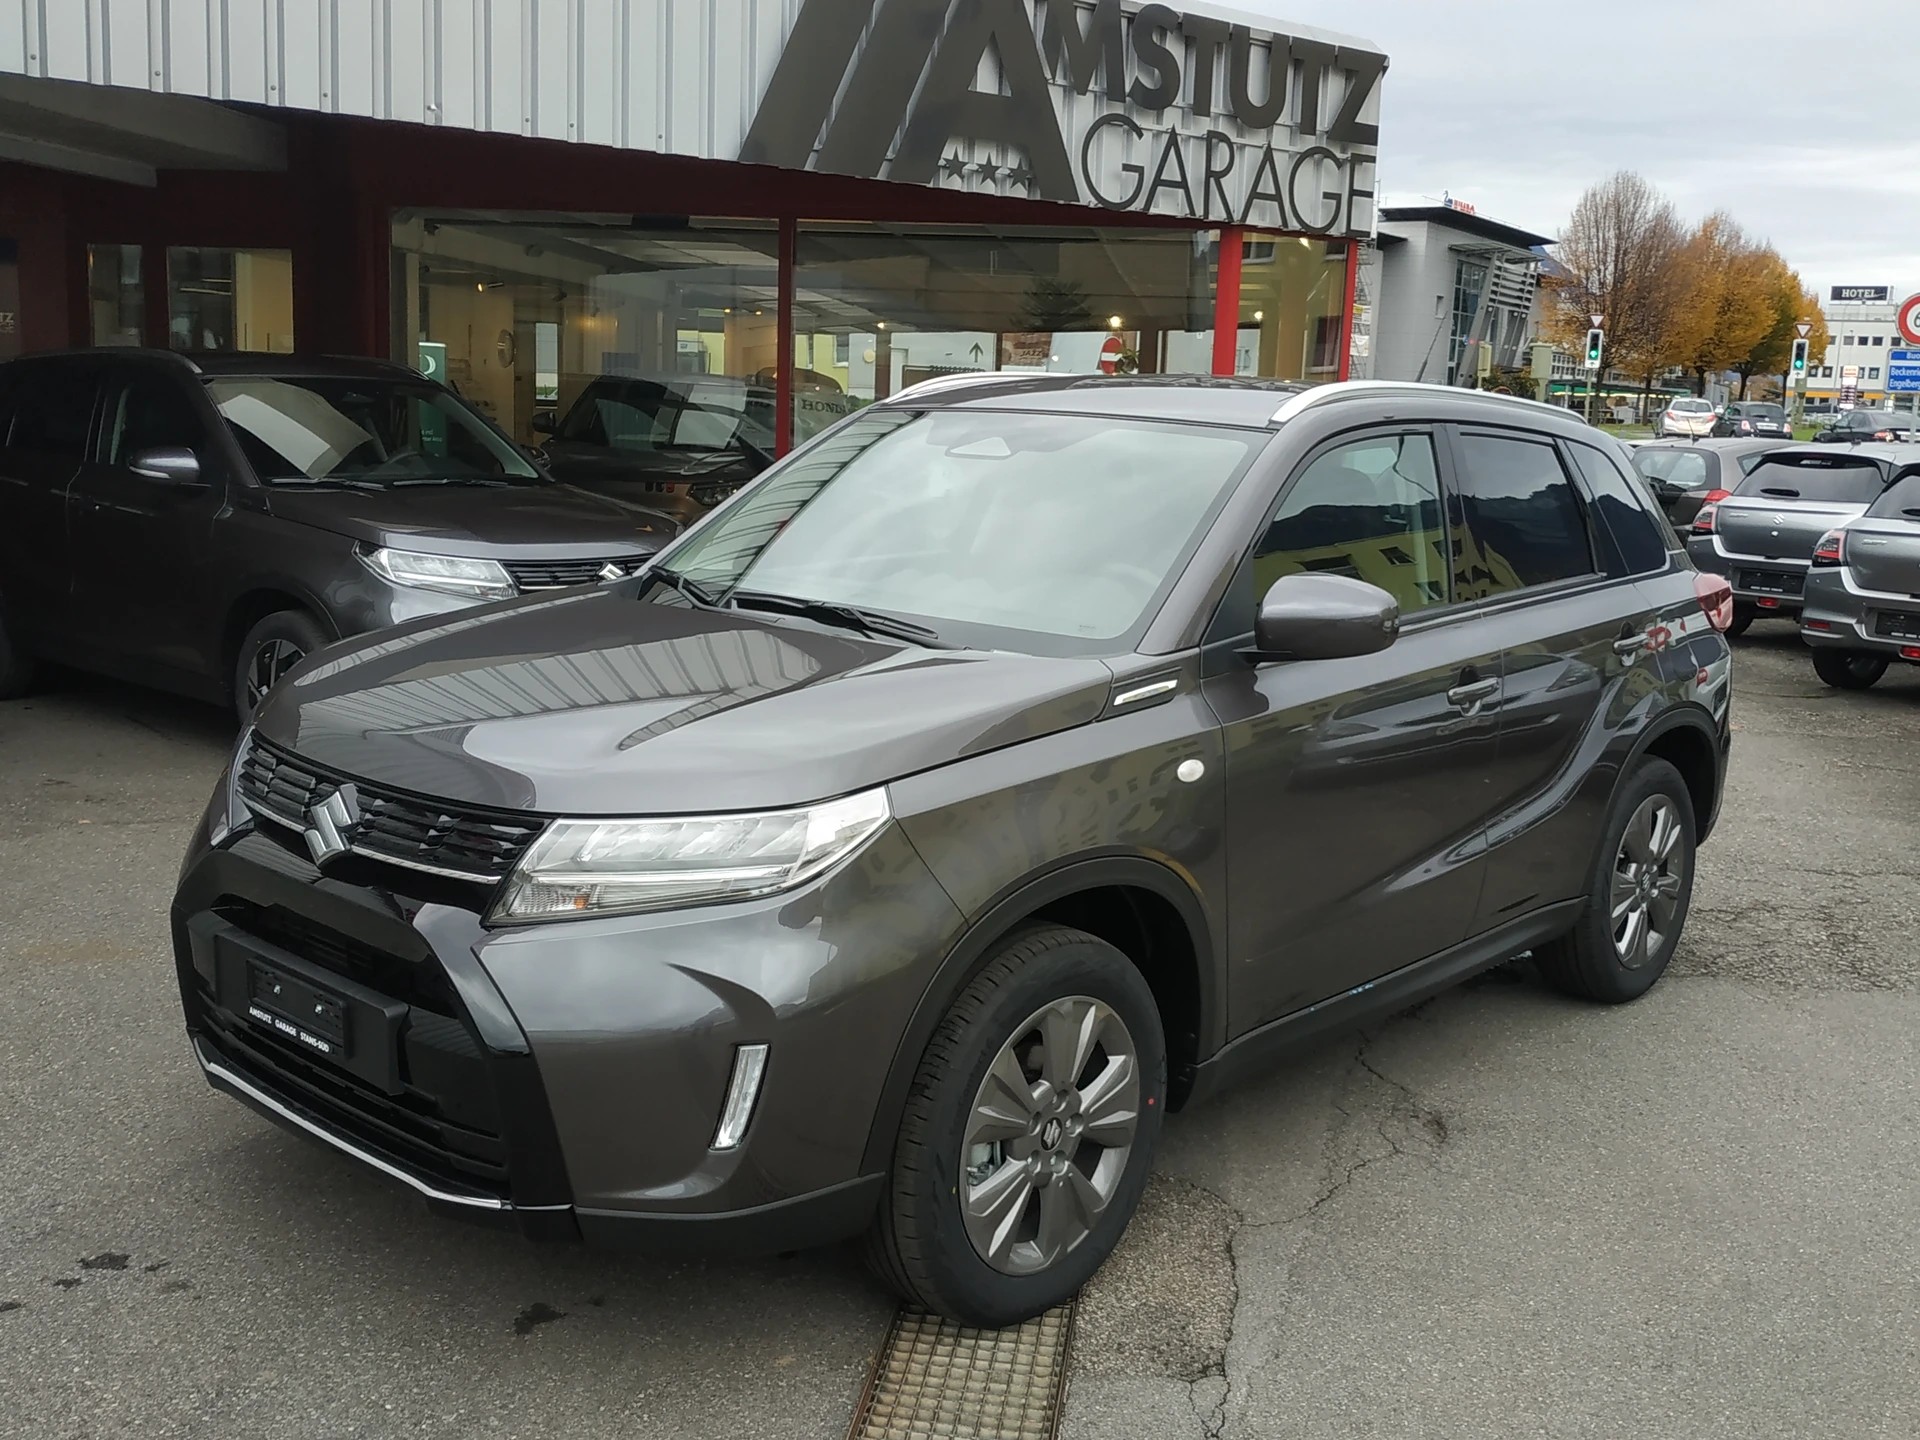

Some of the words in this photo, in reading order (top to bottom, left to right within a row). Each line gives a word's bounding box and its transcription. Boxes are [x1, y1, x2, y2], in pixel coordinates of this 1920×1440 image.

[737, 0, 1389, 202] AMSTUTZ
[1081, 113, 1377, 239] GARAGE
[1841, 289, 1875, 298] HOTEL
[249, 1006, 272, 1023] AMSTUTZ
[275, 1019, 297, 1036] GARAGE
